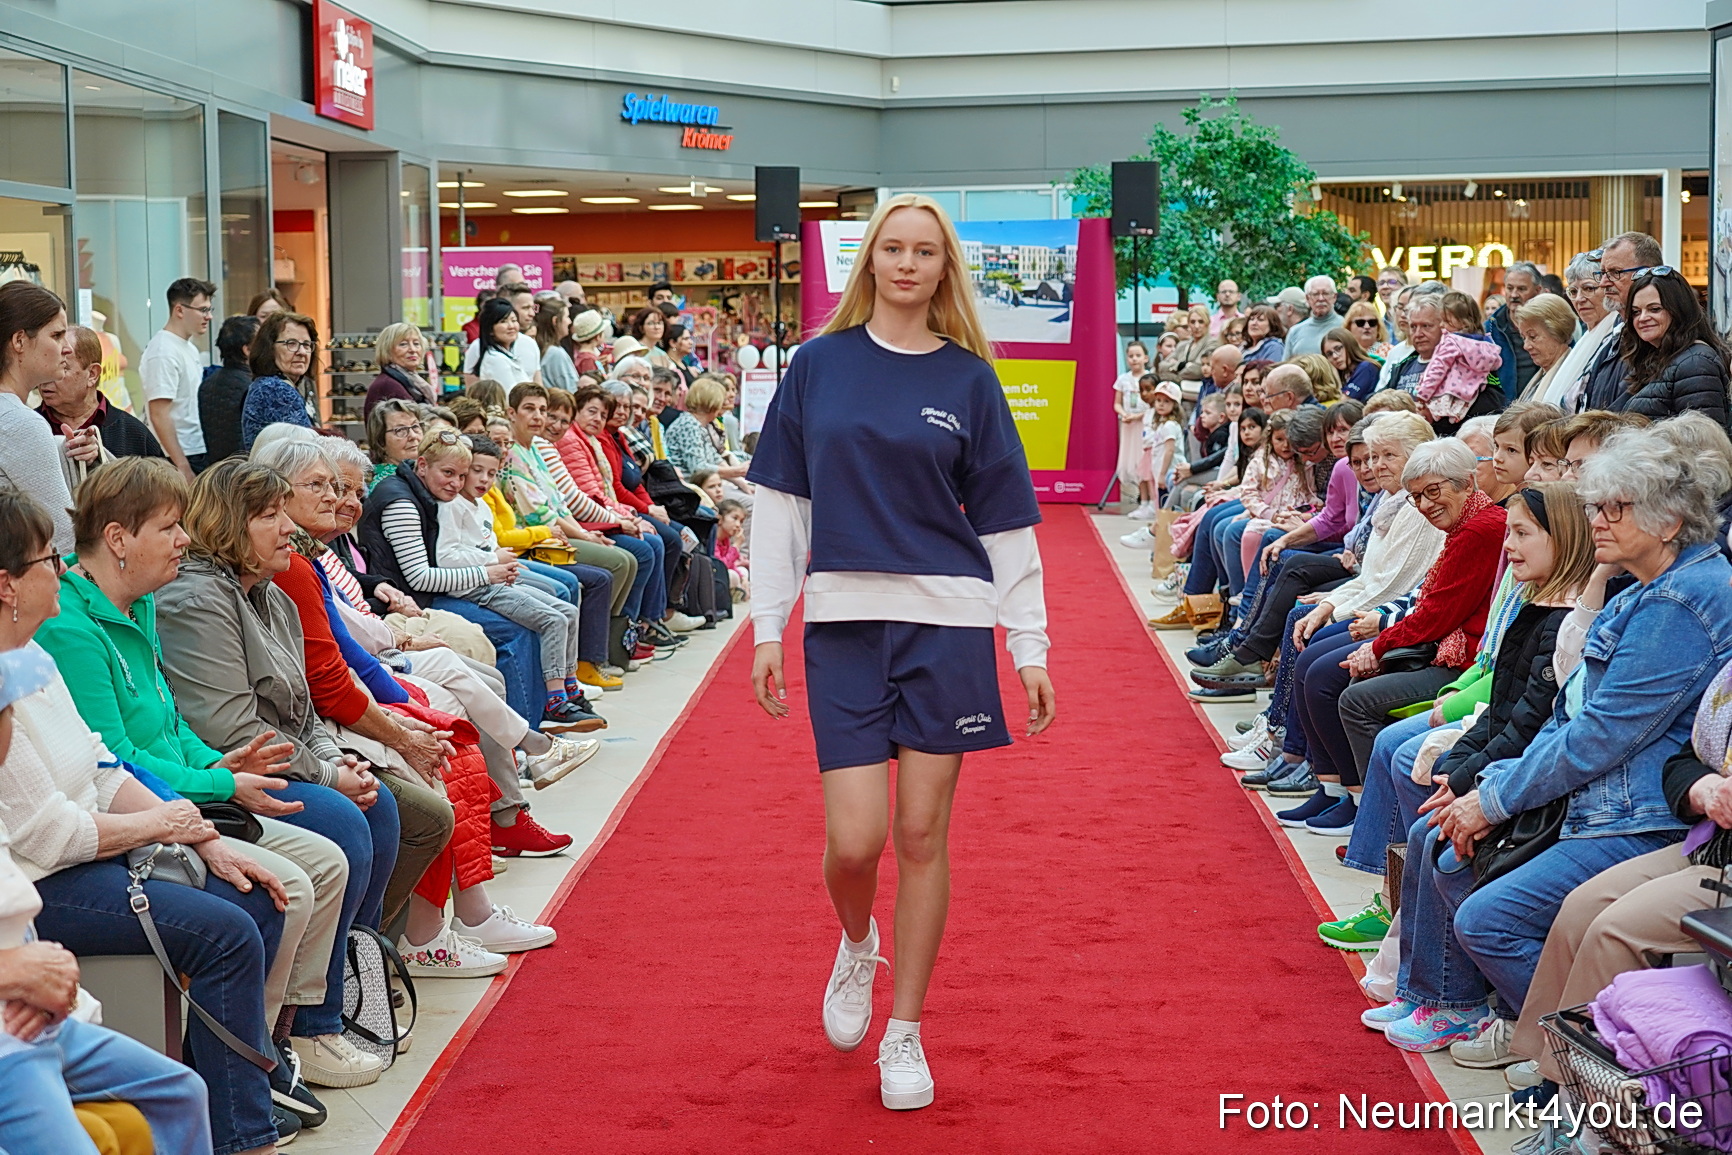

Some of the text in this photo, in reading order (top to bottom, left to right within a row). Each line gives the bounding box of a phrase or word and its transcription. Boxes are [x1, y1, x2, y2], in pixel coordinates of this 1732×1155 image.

[621, 92, 719, 125] Spielwaren
[681, 127, 734, 150] Krömer
[1371, 243, 1514, 279] VERO
[523, 264, 542, 276] Sie
[1021, 383, 1039, 393] Ort
[1012, 410, 1040, 420] chen.
[955, 712, 992, 729] Tennis Club
